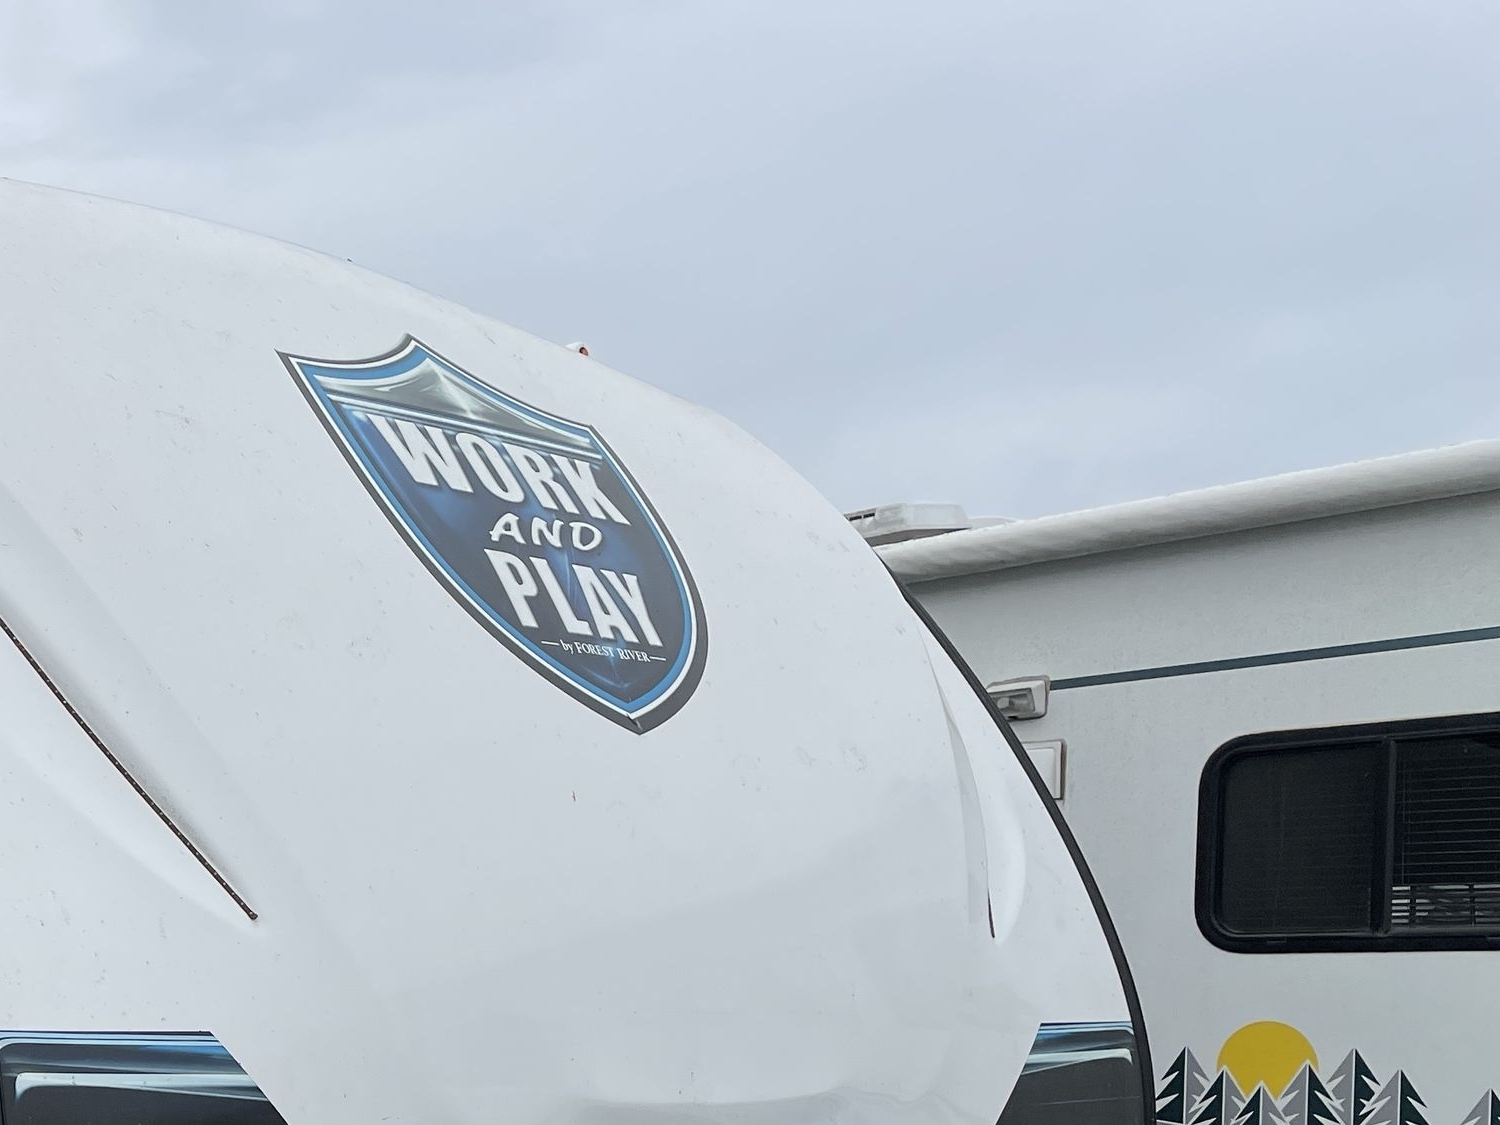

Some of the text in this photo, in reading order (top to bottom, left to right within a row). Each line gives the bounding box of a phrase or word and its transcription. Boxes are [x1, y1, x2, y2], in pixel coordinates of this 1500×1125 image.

[366, 412, 631, 526] WORK
[488, 512, 603, 553] AND
[482, 548, 664, 648] PLAY
[559, 638, 652, 663] by FOREST RIVER
